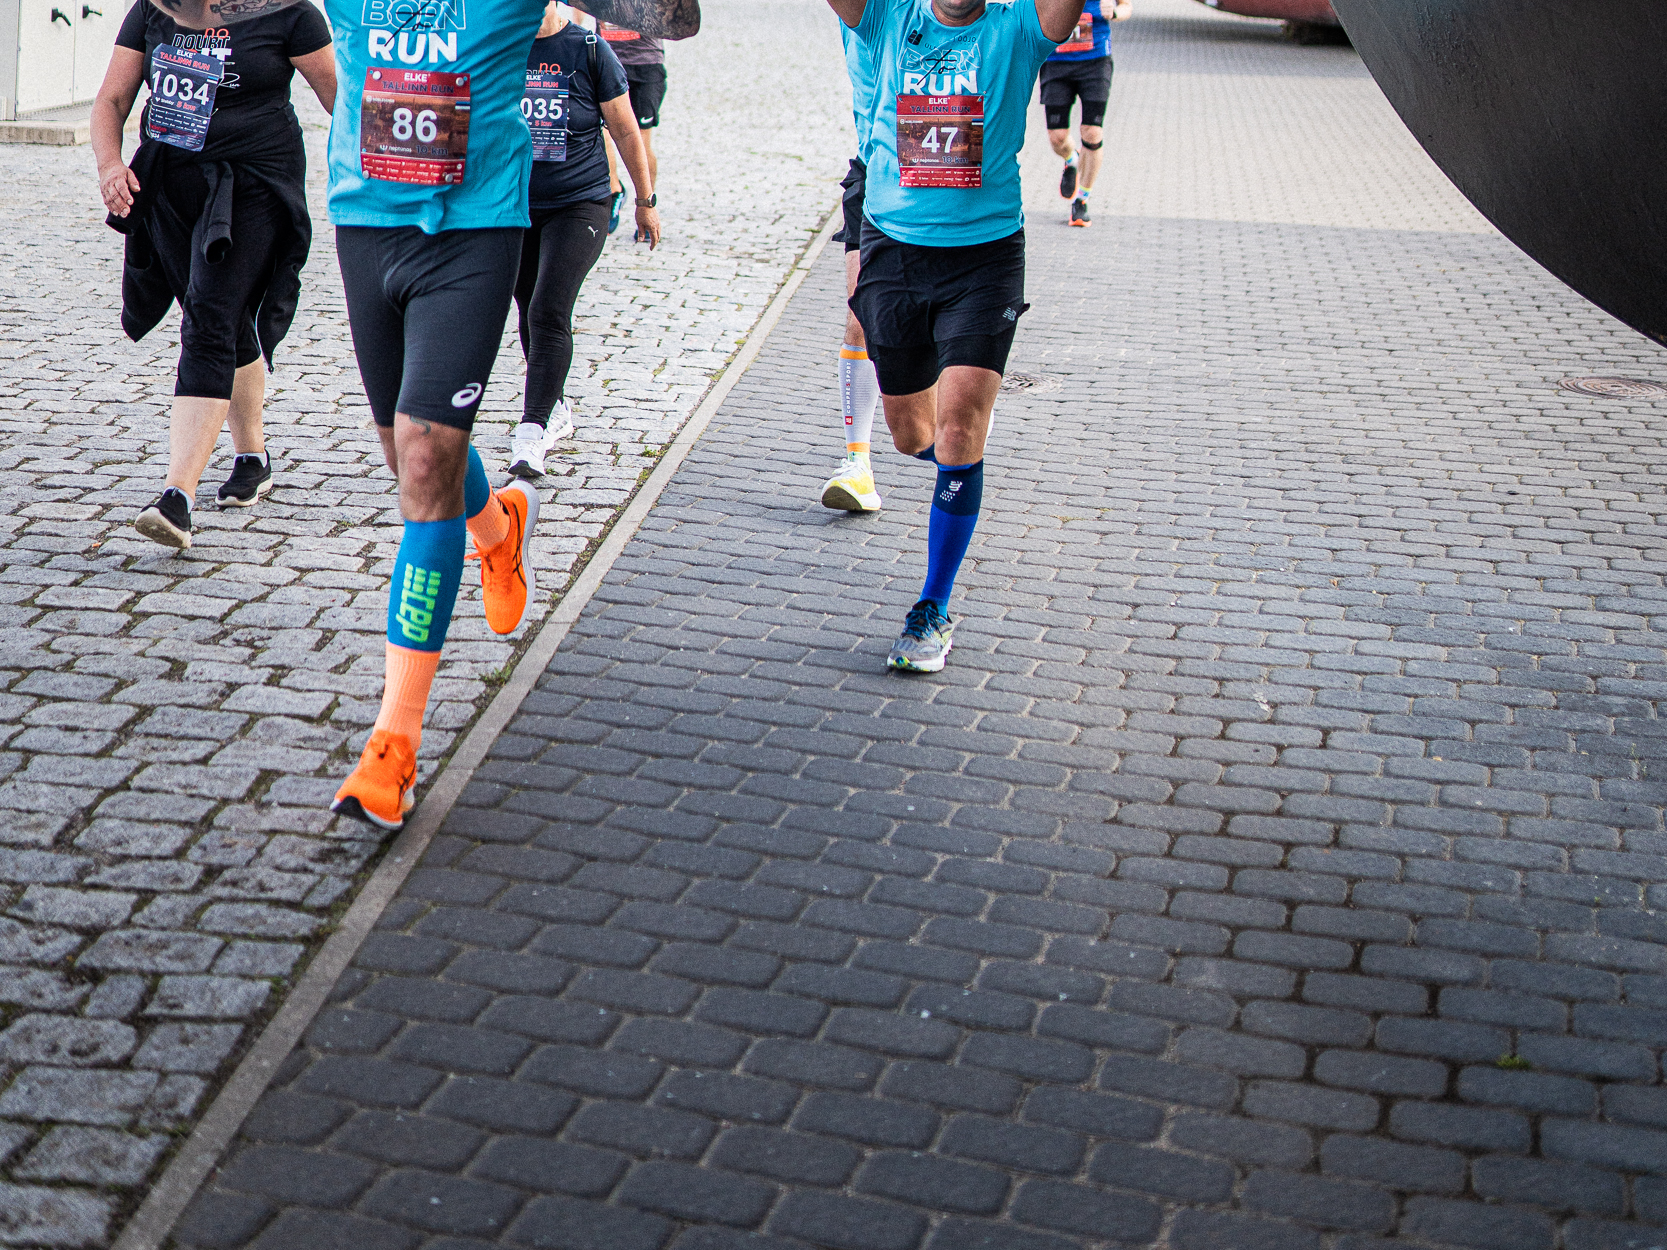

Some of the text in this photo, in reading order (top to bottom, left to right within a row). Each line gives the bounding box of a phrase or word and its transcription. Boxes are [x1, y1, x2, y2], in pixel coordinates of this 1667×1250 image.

[204, 27, 229, 39] no
[171, 33, 231, 51] DOUBT
[368, 29, 457, 64] RUN
[176, 49, 193, 58] ELKE
[899, 42, 981, 74] BORN
[160, 51, 192, 66] TALLINN
[192, 60, 210, 71] RUN
[538, 62, 561, 75] no
[404, 72, 428, 82] ELKE
[903, 70, 978, 96] RUN
[152, 70, 210, 106] 1034
[382, 81, 454, 93] TALLINN RUN
[542, 81, 559, 89] RUN
[928, 97, 948, 105] ELKE
[520, 97, 563, 120] 035
[910, 105, 971, 113] TALLINN RUN
[392, 107, 438, 143] 86
[921, 126, 959, 154] 47
[416, 145, 428, 154] 10
[431, 145, 449, 155] km
[942, 155, 953, 164] 10
[954, 156, 969, 164] km
